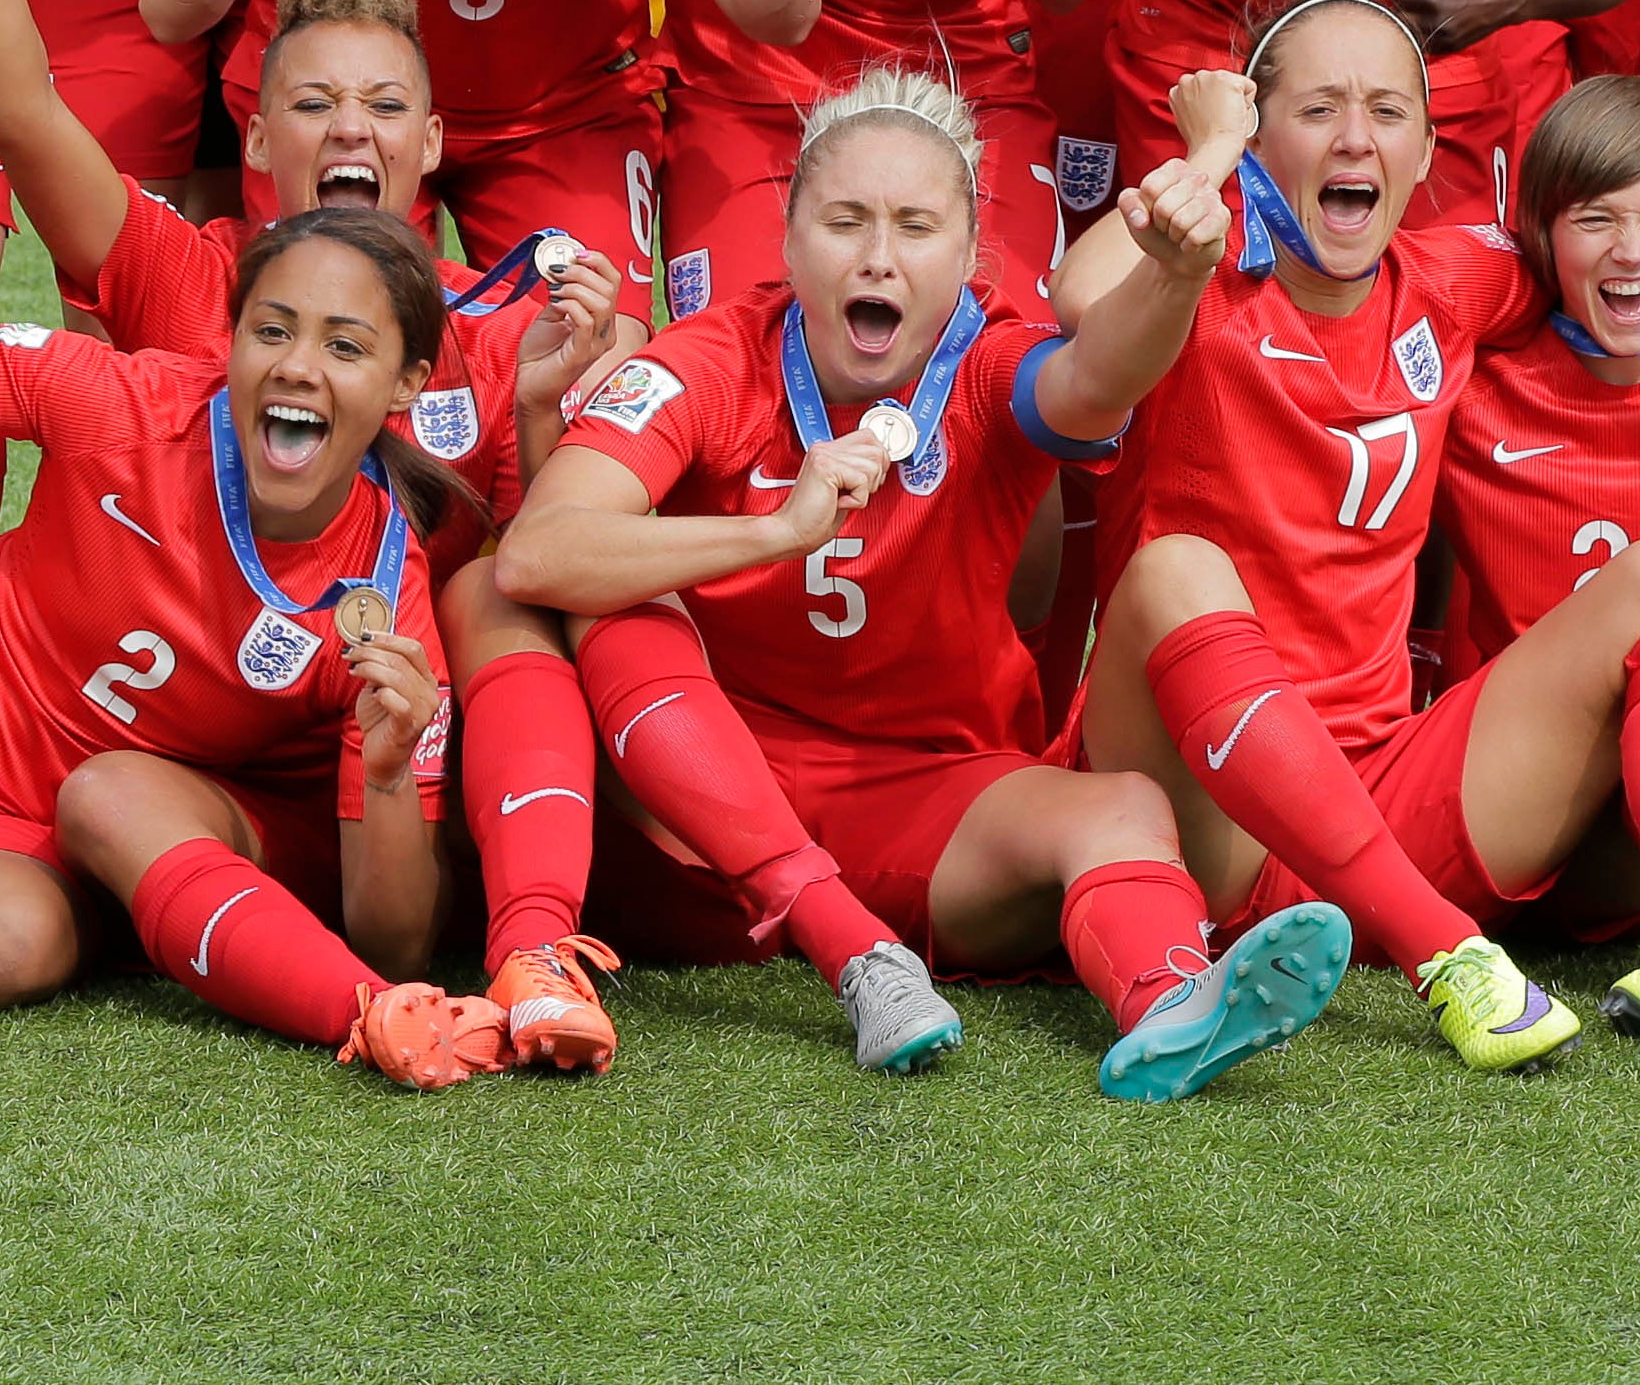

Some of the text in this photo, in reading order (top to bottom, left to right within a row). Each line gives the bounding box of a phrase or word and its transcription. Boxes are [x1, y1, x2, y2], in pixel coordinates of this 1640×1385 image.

[1250, 176, 1271, 199] FIFA
[626, 149, 652, 257] 6
[948, 328, 965, 353] FIFA
[791, 366, 807, 391] FIFA
[931, 363, 949, 386] FIFA
[617, 404, 637, 419] FIFA
[801, 404, 818, 427] FIFA
[919, 394, 934, 419] FIFA
[225, 444, 235, 468] FIFA
[1324, 412, 1419, 530] 17
[227, 484, 238, 510] FIFA
[235, 524, 247, 548] FIFA
[387, 545, 398, 571] FIFA
[806, 537, 867, 638] 5
[82, 630, 176, 725] 2
[422, 715, 449, 745] YOU
